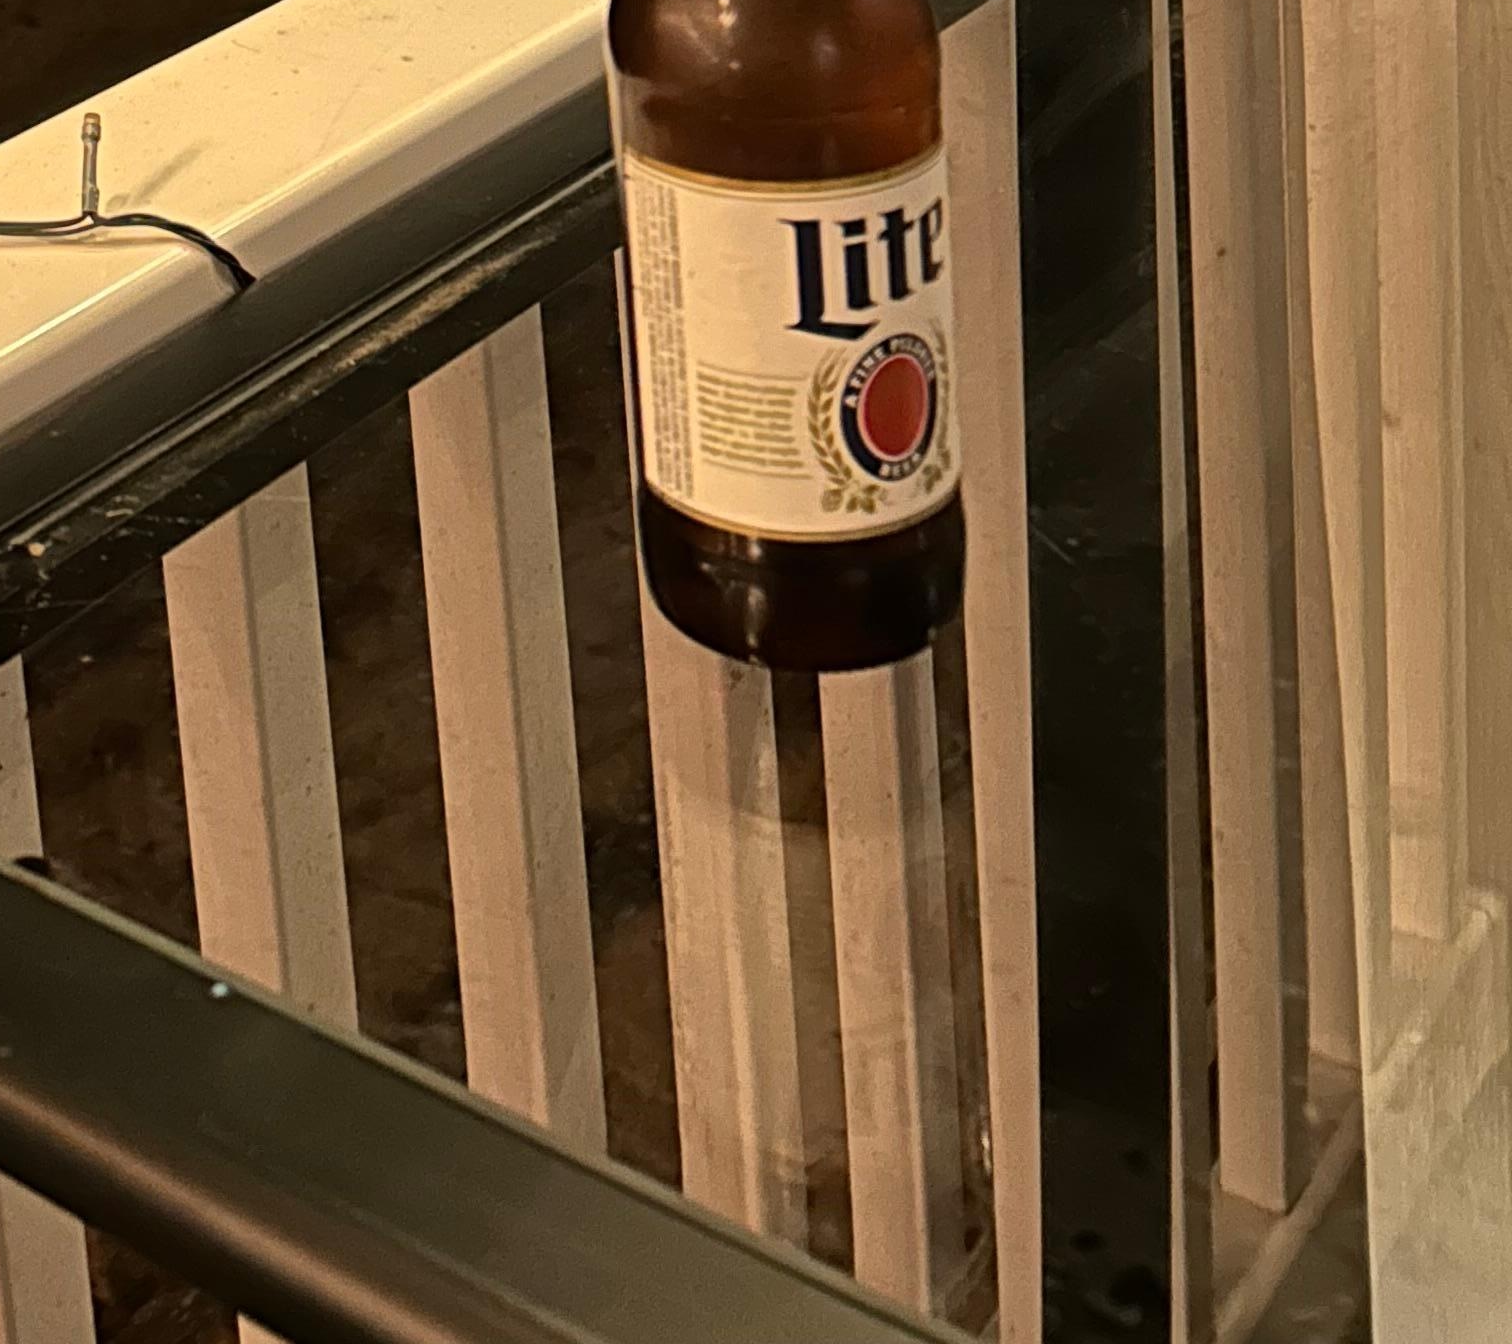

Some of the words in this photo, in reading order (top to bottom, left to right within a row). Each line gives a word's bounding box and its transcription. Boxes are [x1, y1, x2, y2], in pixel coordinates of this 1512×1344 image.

[778, 197, 944, 340] Lite
[850, 346, 886, 387] FINE
[879, 451, 922, 479] BEER
